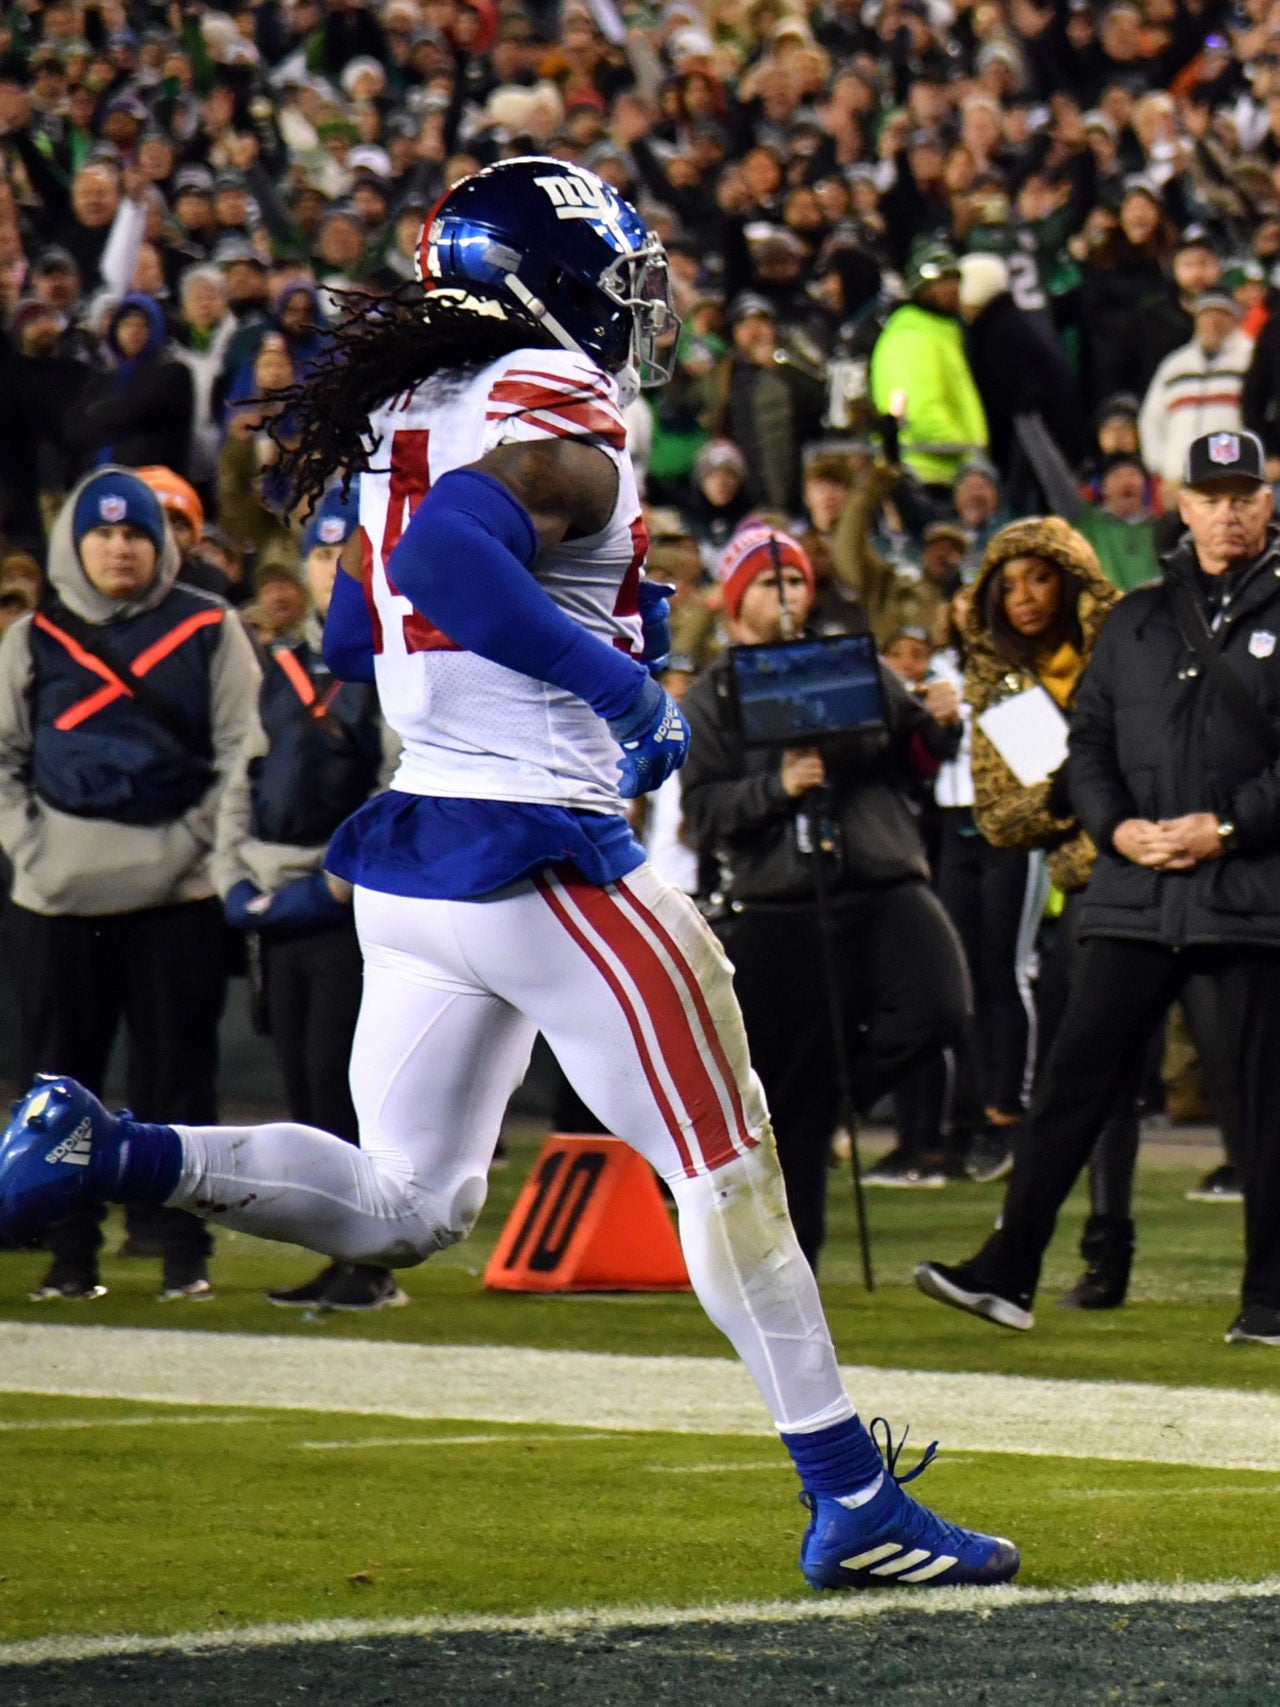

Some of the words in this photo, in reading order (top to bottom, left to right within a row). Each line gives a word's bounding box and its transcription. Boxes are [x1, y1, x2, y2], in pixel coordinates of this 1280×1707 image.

[653, 695, 675, 743] adidas
[45, 1116, 92, 1164] adidas
[504, 1151, 607, 1271] 10
